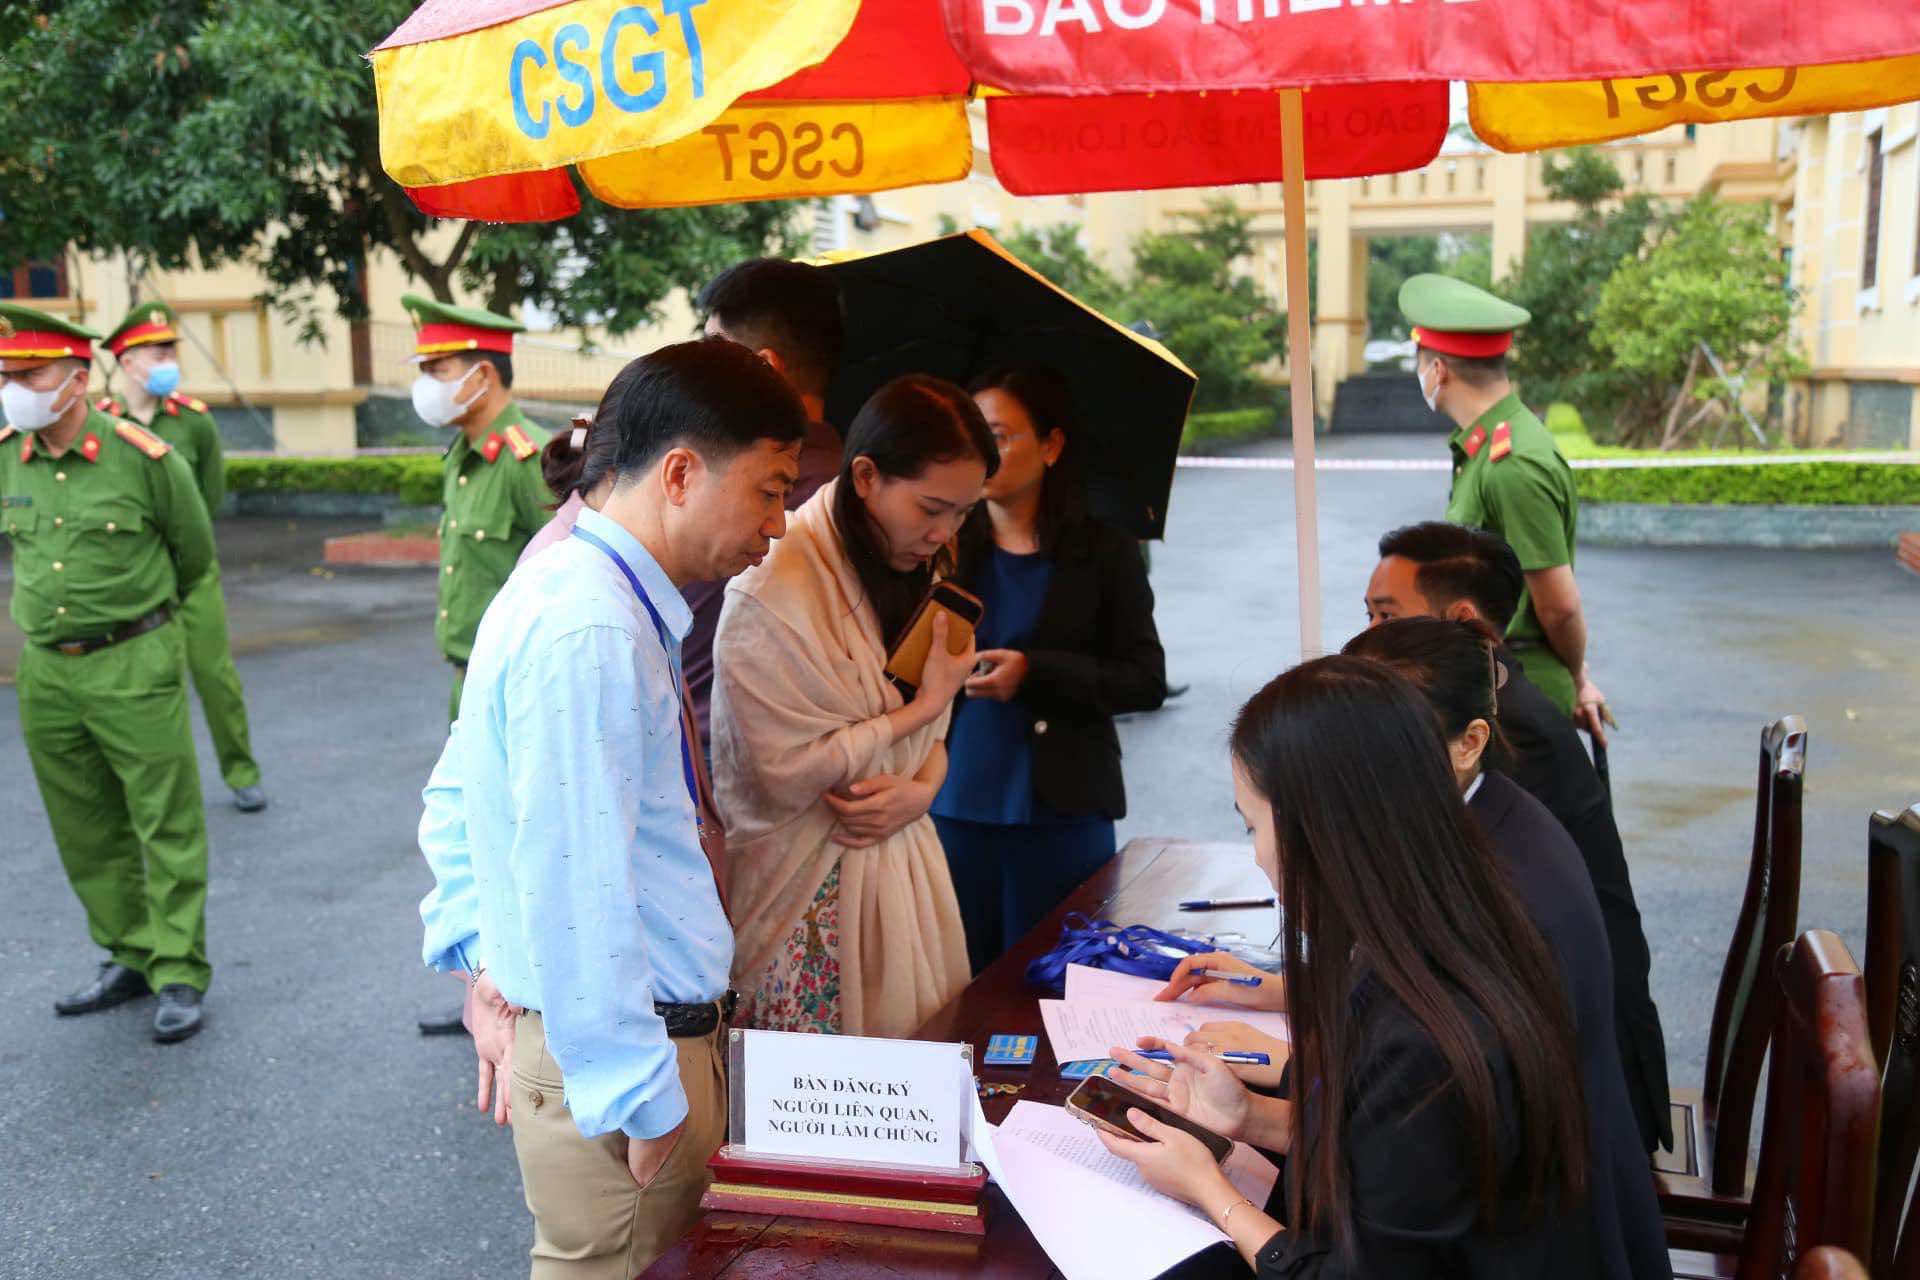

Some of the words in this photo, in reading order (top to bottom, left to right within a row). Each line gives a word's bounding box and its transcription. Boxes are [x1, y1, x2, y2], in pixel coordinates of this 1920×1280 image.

[509, 0, 706, 140] CSGT
[772, 1098, 829, 1115] NGƯỜI
[835, 1101, 875, 1118] LIÊN
[879, 1104, 934, 1124] QUAN,
[768, 1119, 825, 1136] NGƯỜI
[873, 1125, 938, 1143] CHỨNG
